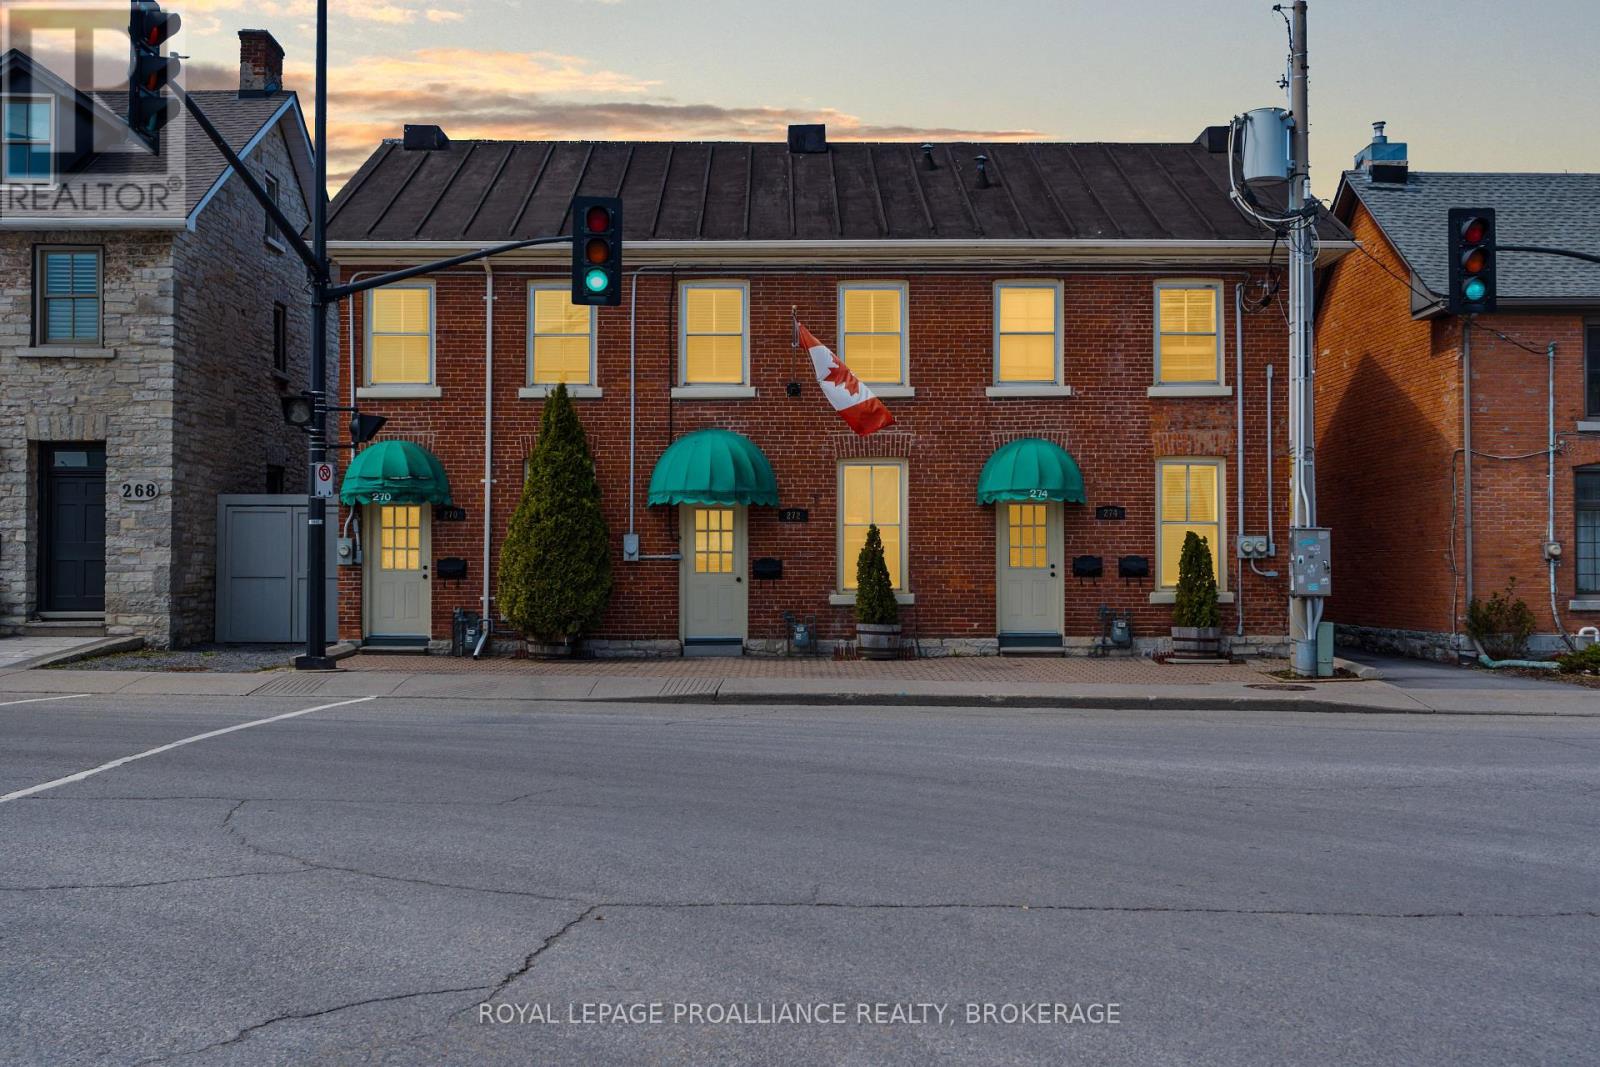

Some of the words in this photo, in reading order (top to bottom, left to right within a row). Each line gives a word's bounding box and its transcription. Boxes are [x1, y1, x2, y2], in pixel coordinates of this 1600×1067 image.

[122, 483, 156, 498] 268
[1029, 489, 1048, 499] 274
[372, 492, 392, 501] 270
